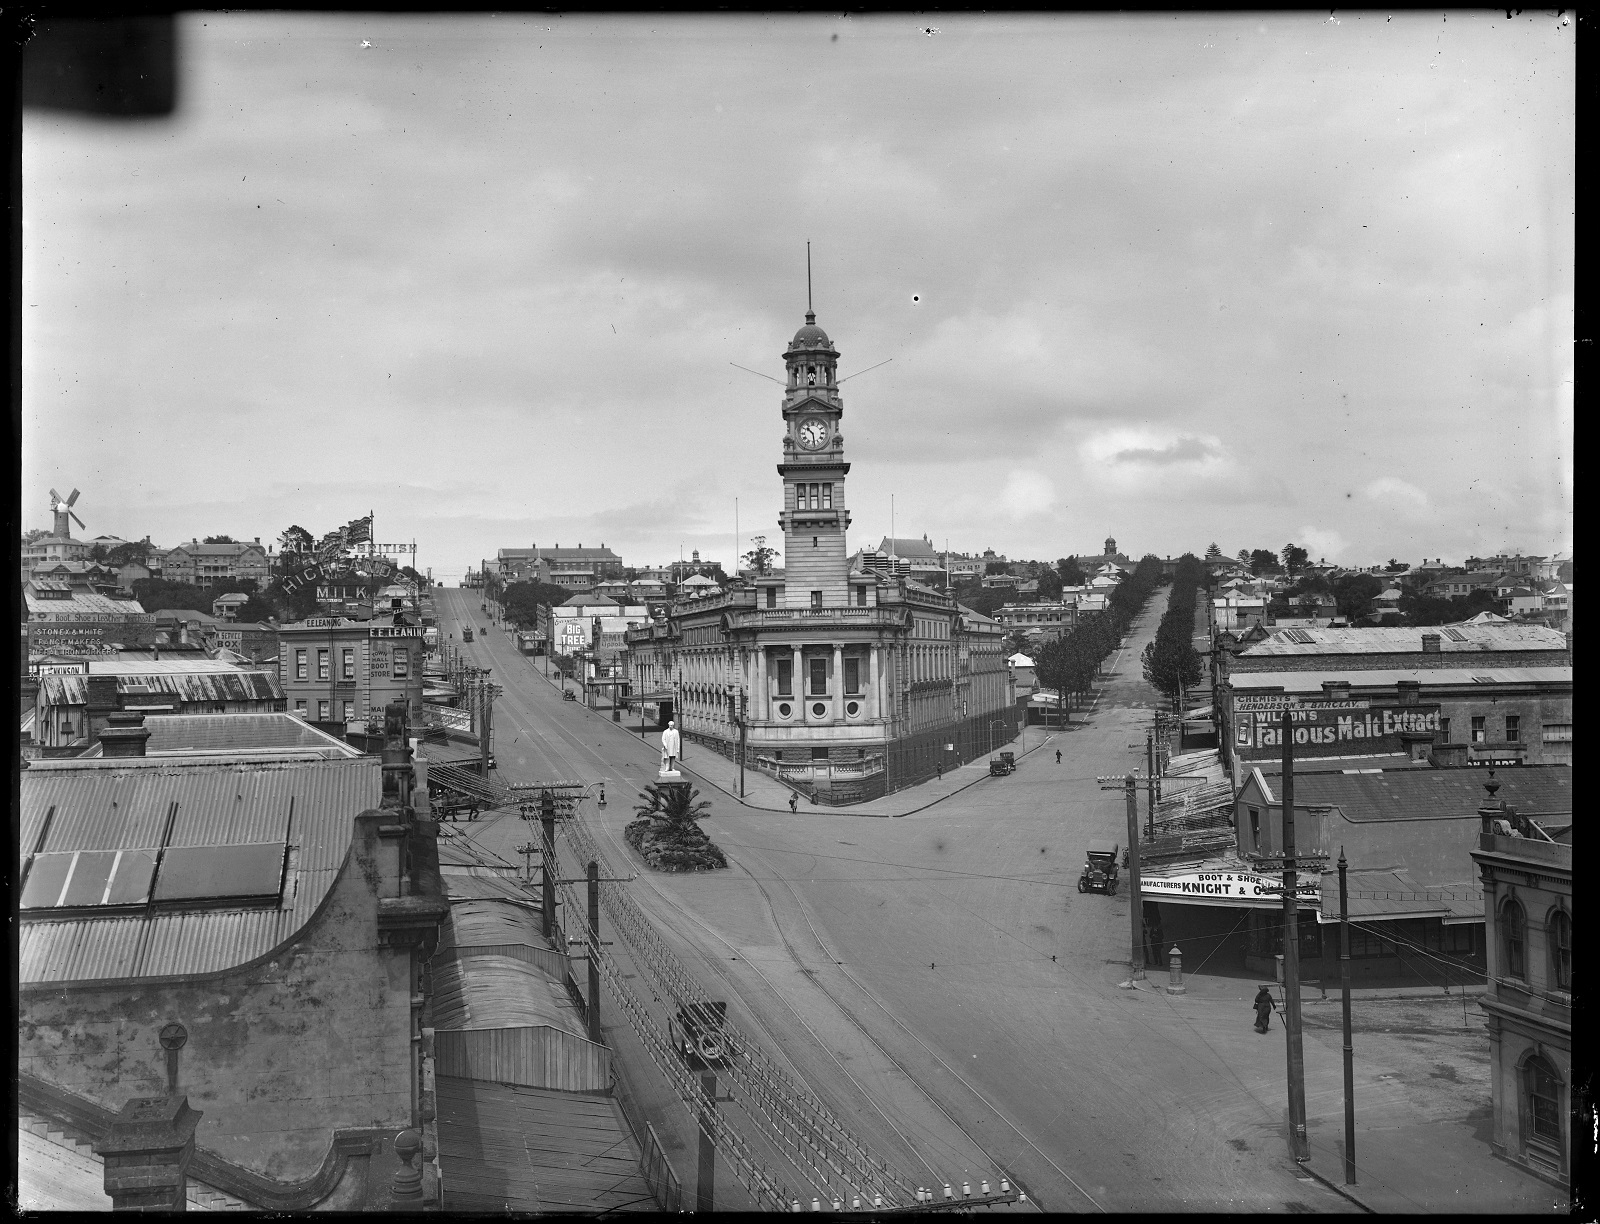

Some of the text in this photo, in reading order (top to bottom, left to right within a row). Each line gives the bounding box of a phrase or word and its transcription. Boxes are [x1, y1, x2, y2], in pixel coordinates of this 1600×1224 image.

[286, 541, 321, 553] ALL
[316, 586, 368, 598] MILK
[75, 613, 90, 622] Shoe
[567, 624, 581, 634] BIG
[217, 640, 238, 648] BOX
[561, 634, 585, 645] TREE
[28, 648, 60, 656] ENERAL
[371, 662, 389, 670] BOOT
[370, 670, 391, 678] STORE
[1237, 695, 1291, 703] CHEMISTS
[1239, 703, 1296, 711] HENDERSON
[1310, 700, 1358, 709] BARCLAY
[1255, 710, 1318, 722] WILON'S
[1337, 713, 1383, 740] Malt
[1382, 709, 1441, 734] Extract
[1198, 874, 1223, 882] BOOT
[1237, 875, 1262, 885] SHOE
[1141, 880, 1182, 889] ANUFACTURERS
[1182, 882, 1232, 895] KNIGHT
[1238, 886, 1247, 896] &
